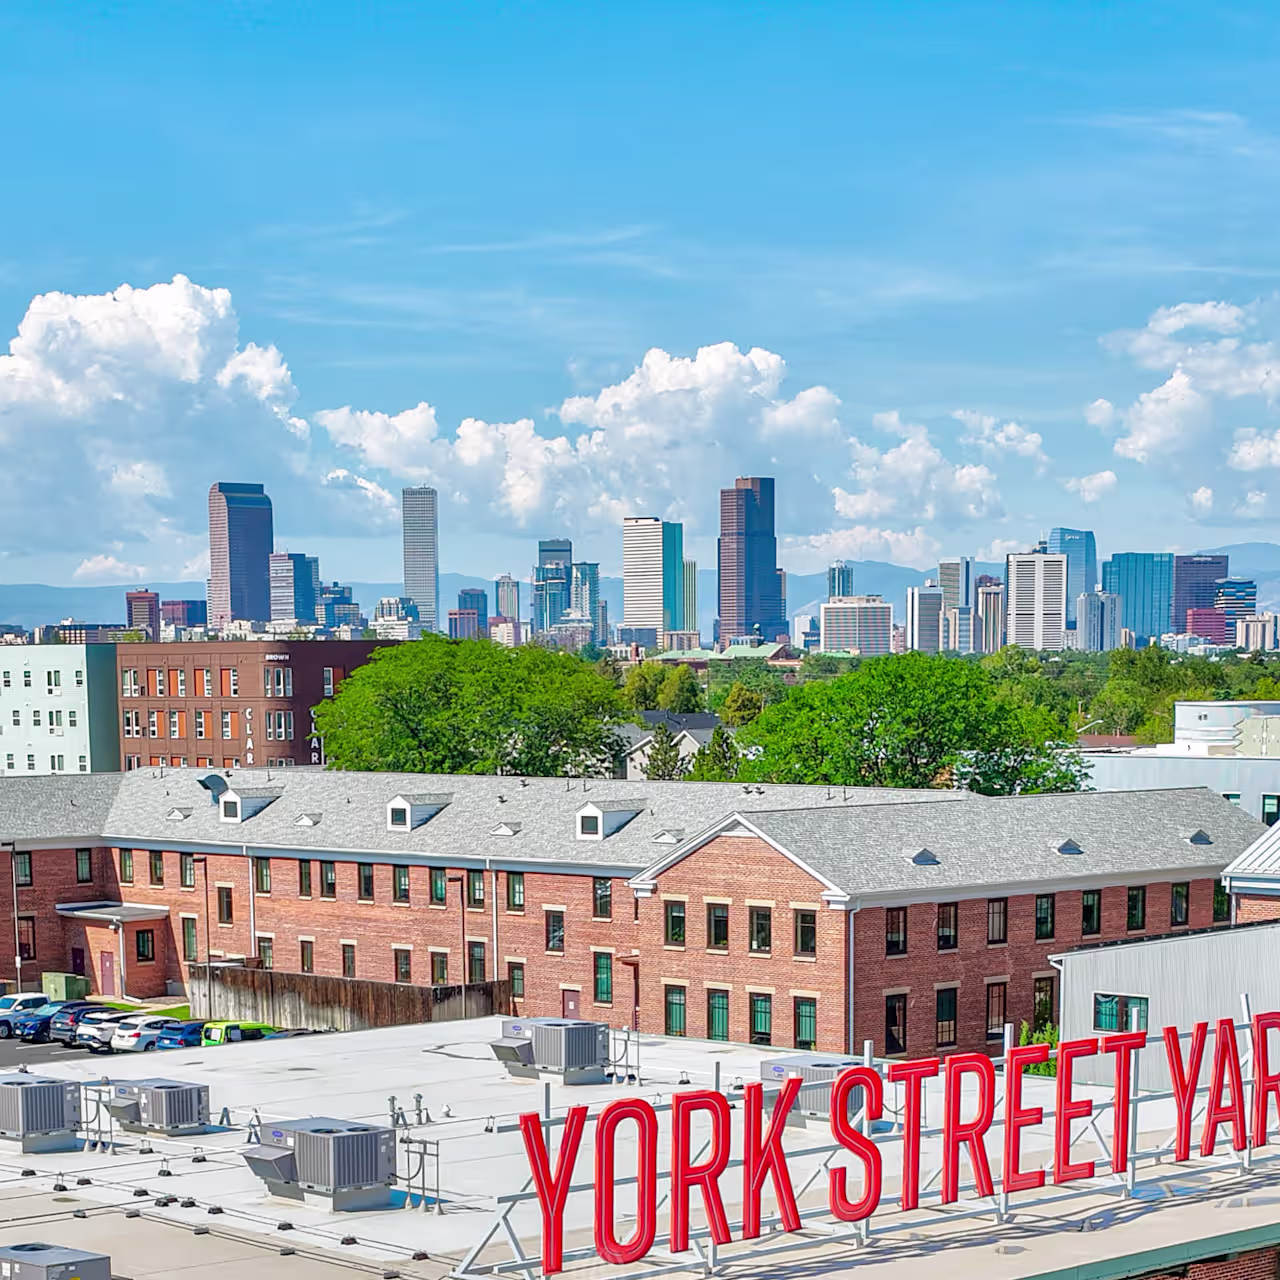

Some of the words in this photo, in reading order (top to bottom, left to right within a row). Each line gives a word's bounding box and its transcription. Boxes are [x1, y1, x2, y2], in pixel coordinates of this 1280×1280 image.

[265, 653, 290, 661] BROWN
[517, 1076, 803, 1277] YORK
[829, 1031, 1148, 1222] STREET
